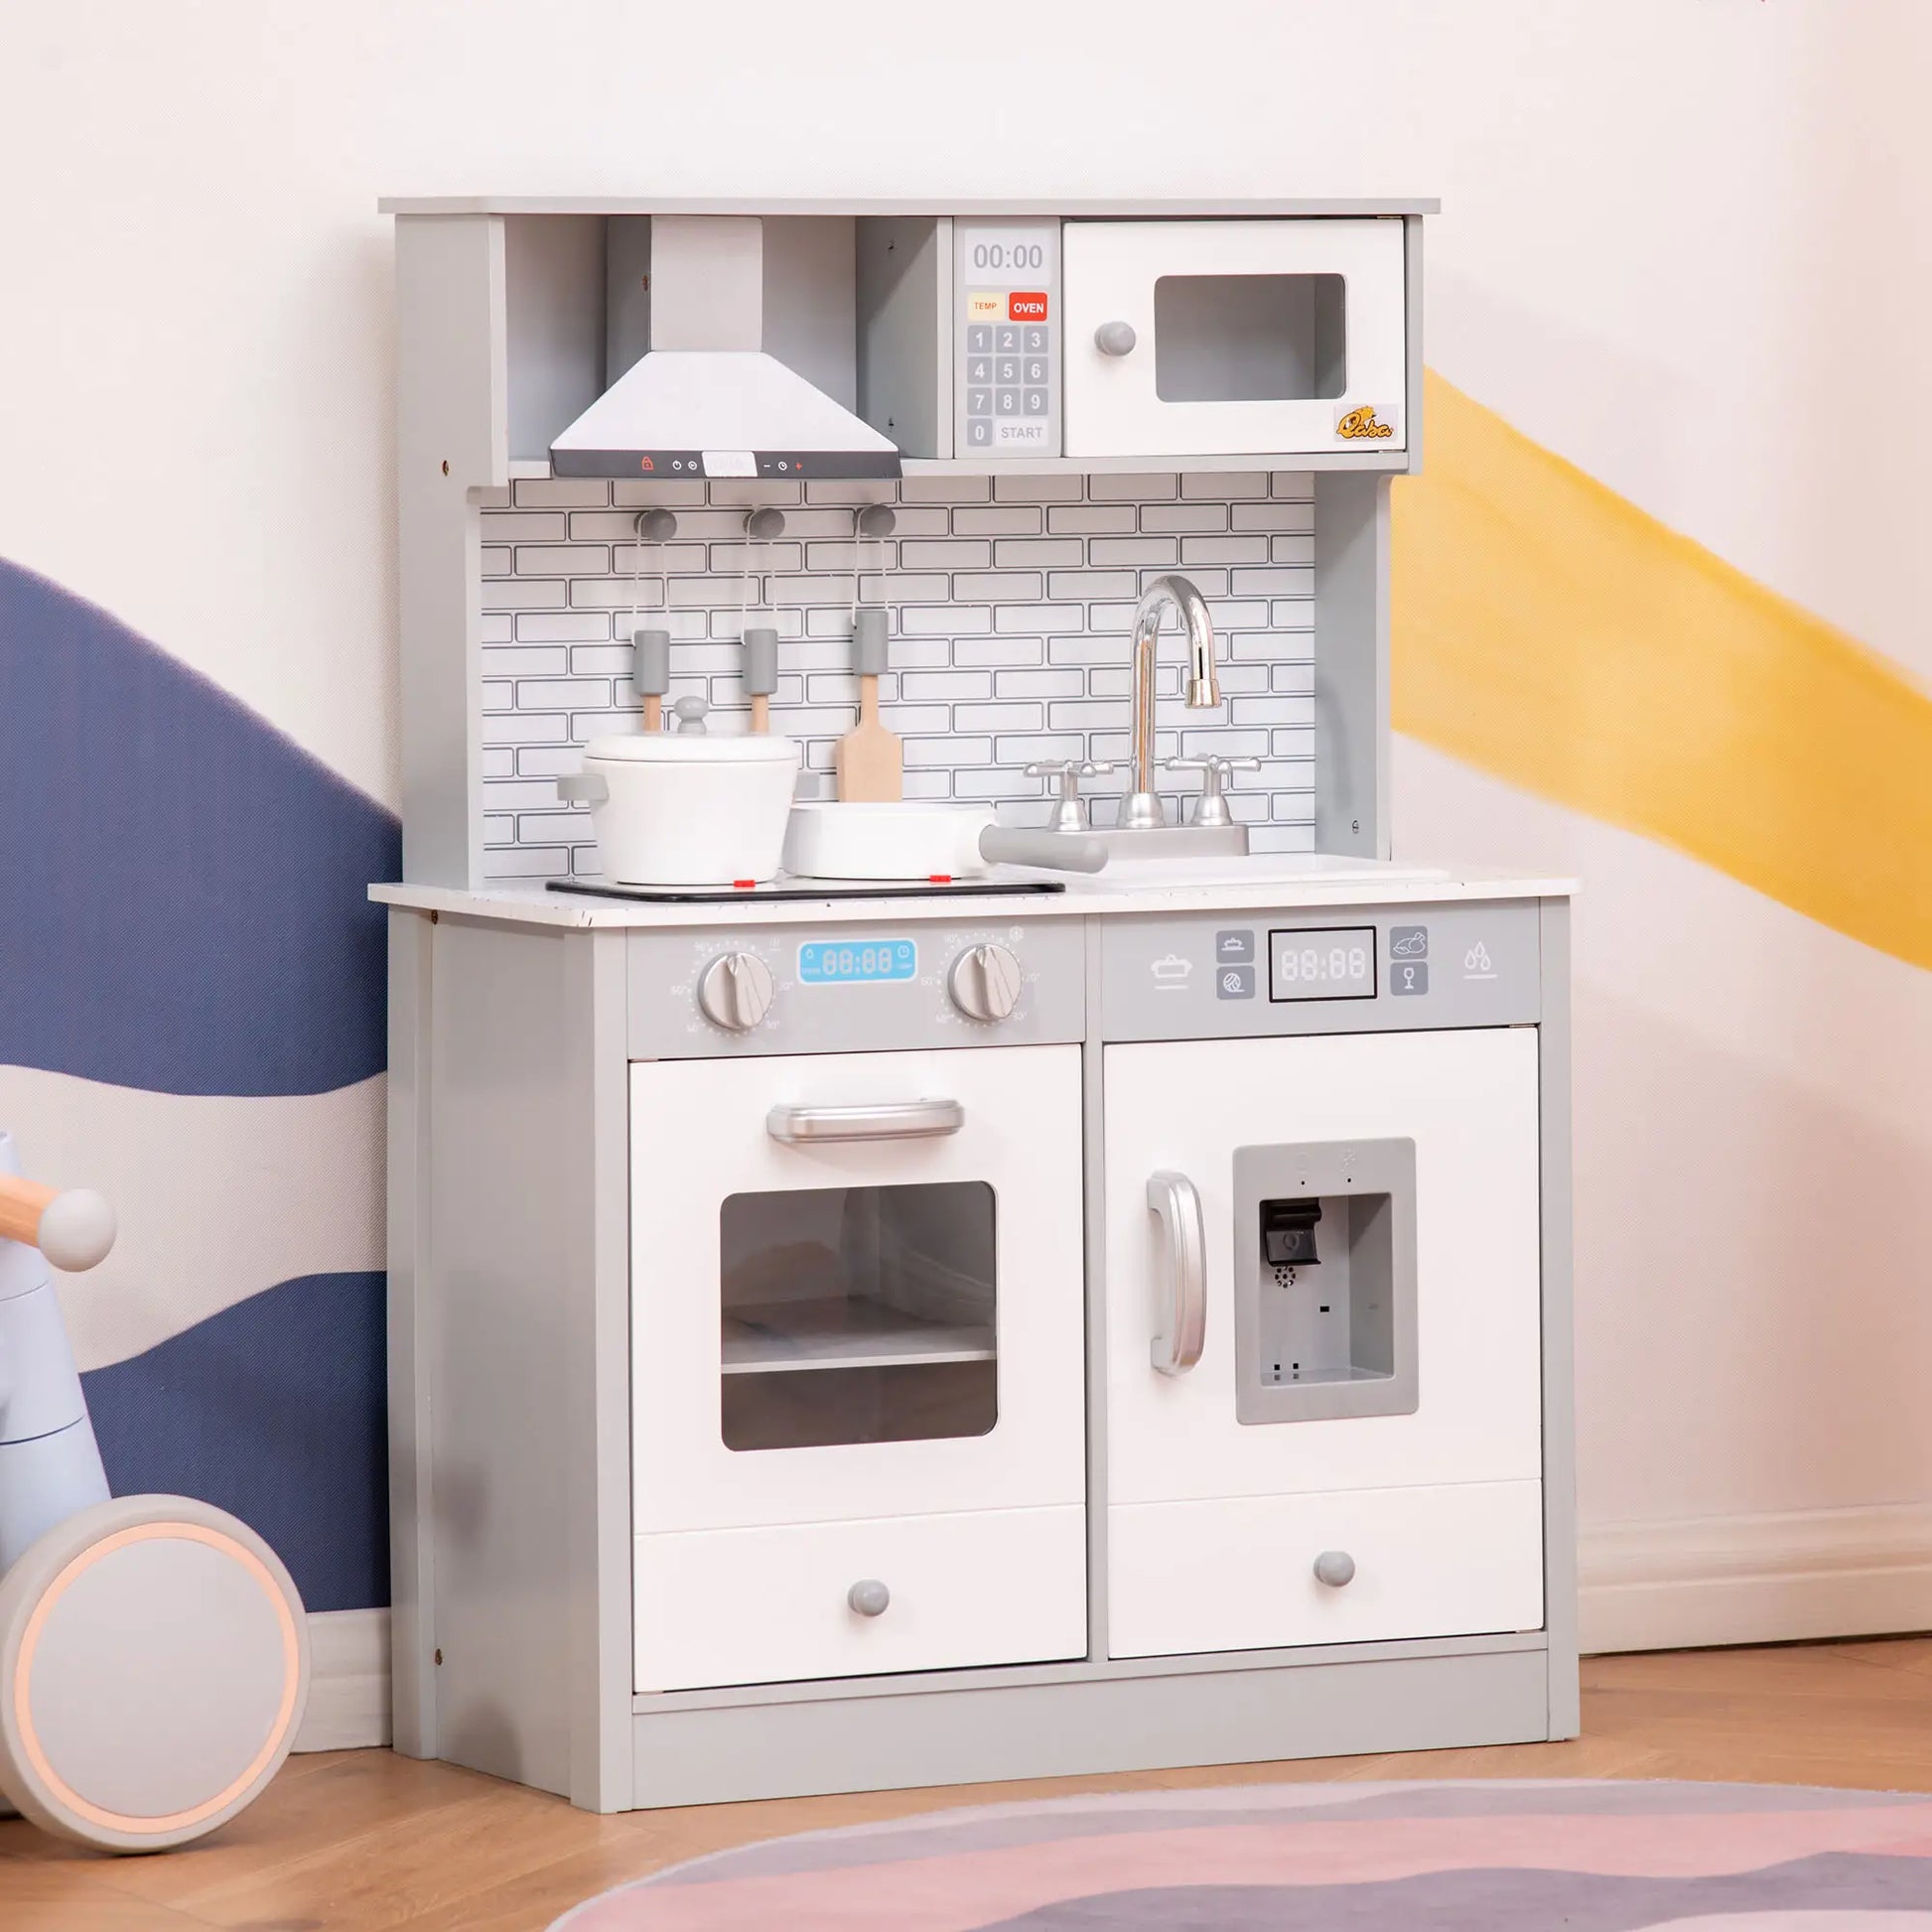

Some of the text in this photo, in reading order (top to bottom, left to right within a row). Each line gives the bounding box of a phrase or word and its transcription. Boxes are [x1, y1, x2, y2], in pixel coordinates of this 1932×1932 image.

[973, 244, 1042, 269] 00:00
[974, 302, 1044, 314] TEMP OVEN
[975, 333, 1041, 347] 1 2 3
[974, 363, 1041, 378] 4 5 6
[975, 394, 1041, 409] 7 8 9
[975, 425, 1042, 440] 0 START
